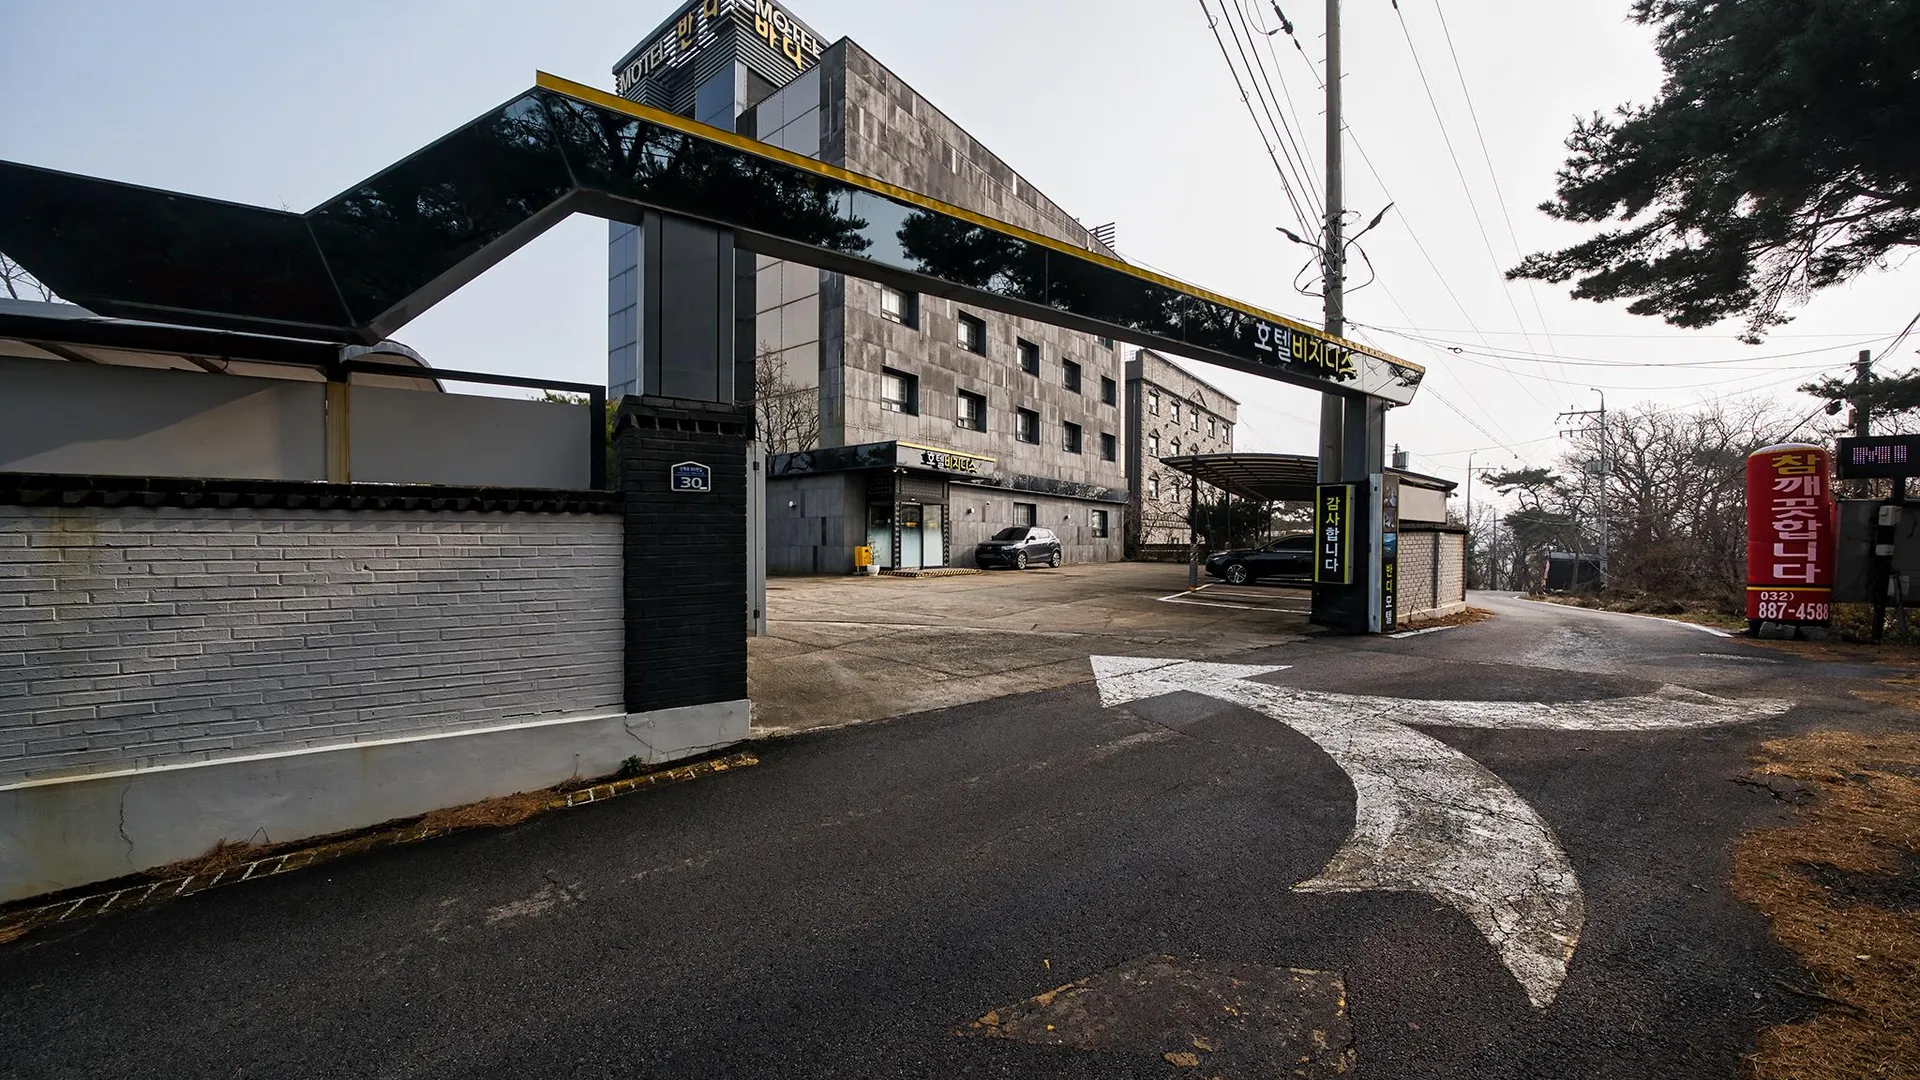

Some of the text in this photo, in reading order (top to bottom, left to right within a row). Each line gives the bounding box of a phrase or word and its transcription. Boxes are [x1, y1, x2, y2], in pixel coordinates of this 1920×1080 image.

[755, 0, 823, 60] MOTEL
[620, 40, 669, 93] MOTEL
[680, 476, 703, 489] 30
[1325, 496, 1341, 573] 감사합니다
[1758, 602, 1829, 620] 887-4588
[1760, 591, 1795, 601] 032)
